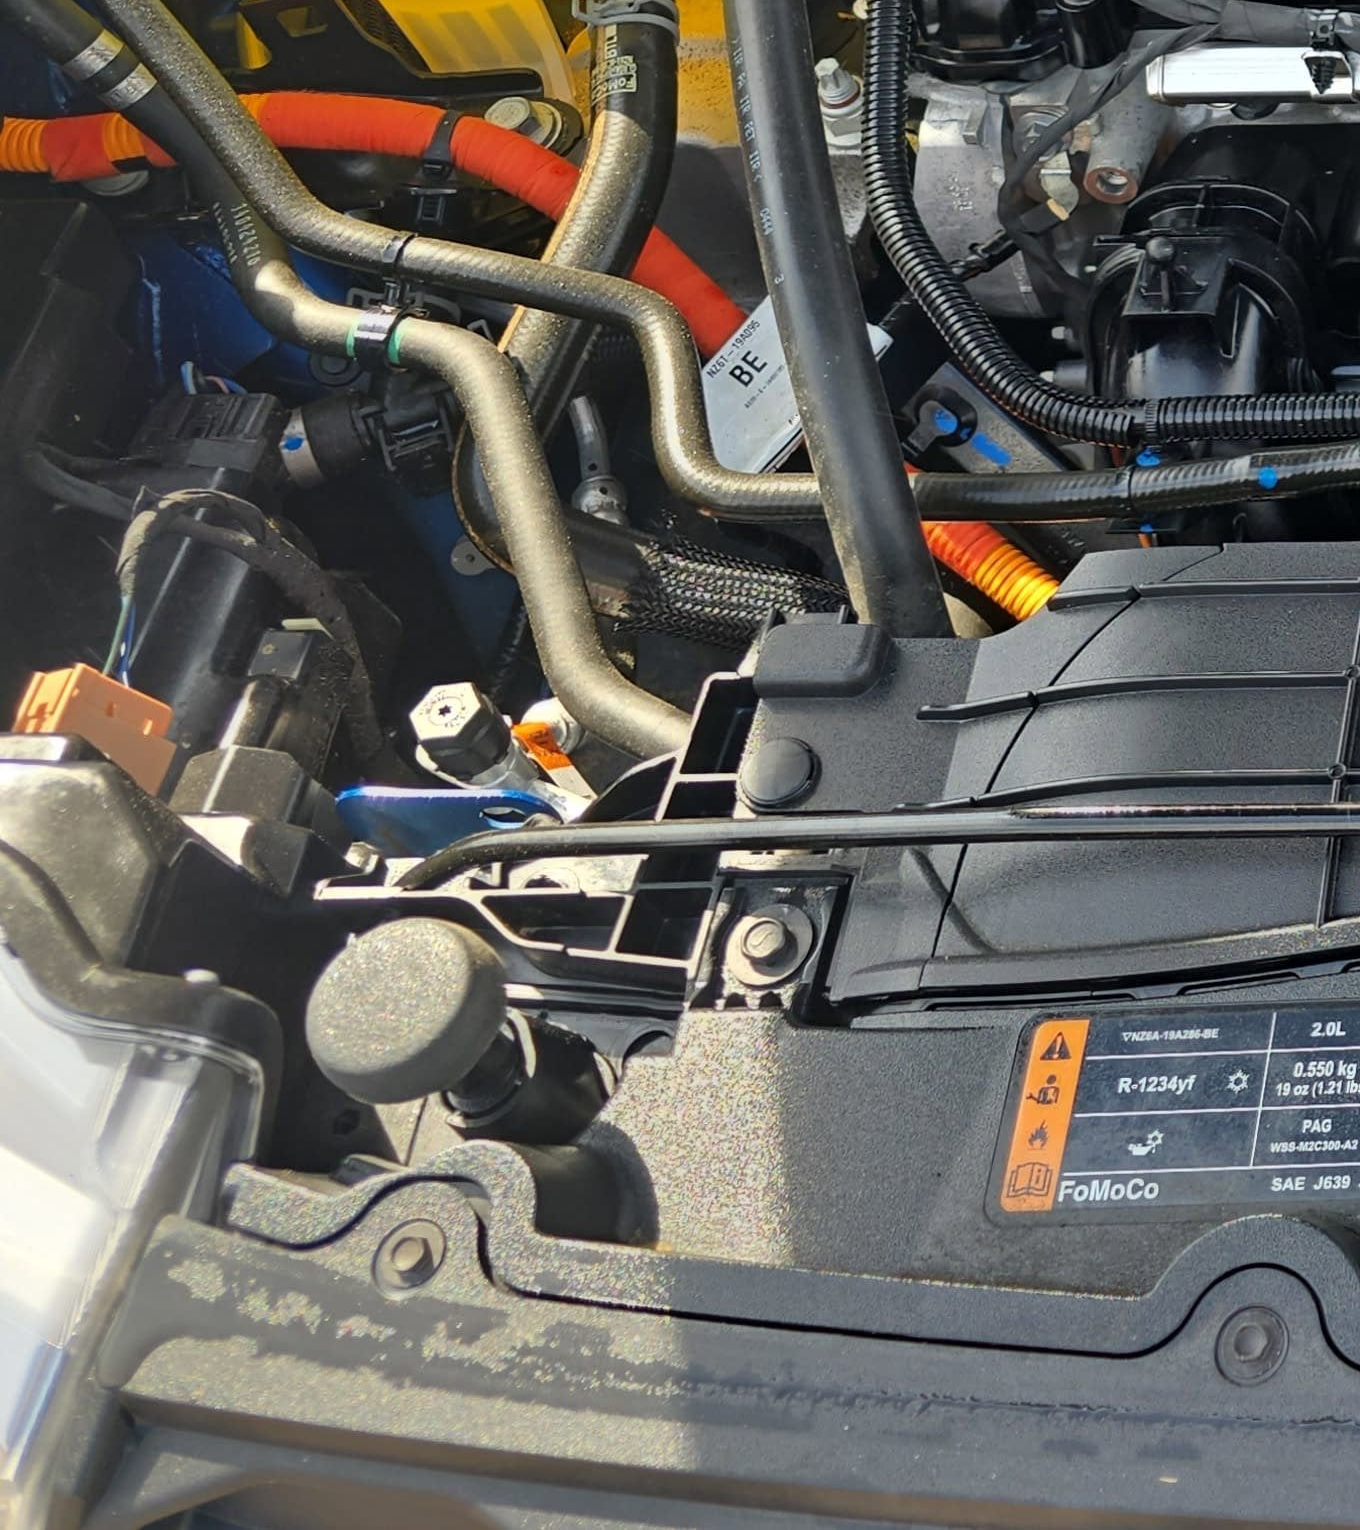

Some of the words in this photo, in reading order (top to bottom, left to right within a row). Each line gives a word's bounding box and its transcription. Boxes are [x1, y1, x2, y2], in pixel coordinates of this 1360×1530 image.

[728, 350, 768, 389] BE
[1310, 1021, 1347, 1038] 2.0L
[1292, 1060, 1334, 1078] 0.550
[1336, 1060, 1358, 1079] kg
[1117, 1074, 1197, 1095] R-1234yf
[1276, 1082, 1292, 1097] 19
[1293, 1084, 1310, 1096] oz
[1311, 1080, 1344, 1098] (1.21
[1302, 1119, 1333, 1134] PAG
[1057, 1178, 1160, 1203] FoMoCo
[1270, 1175, 1307, 1192] SAE
[1313, 1174, 1351, 1191] J639
